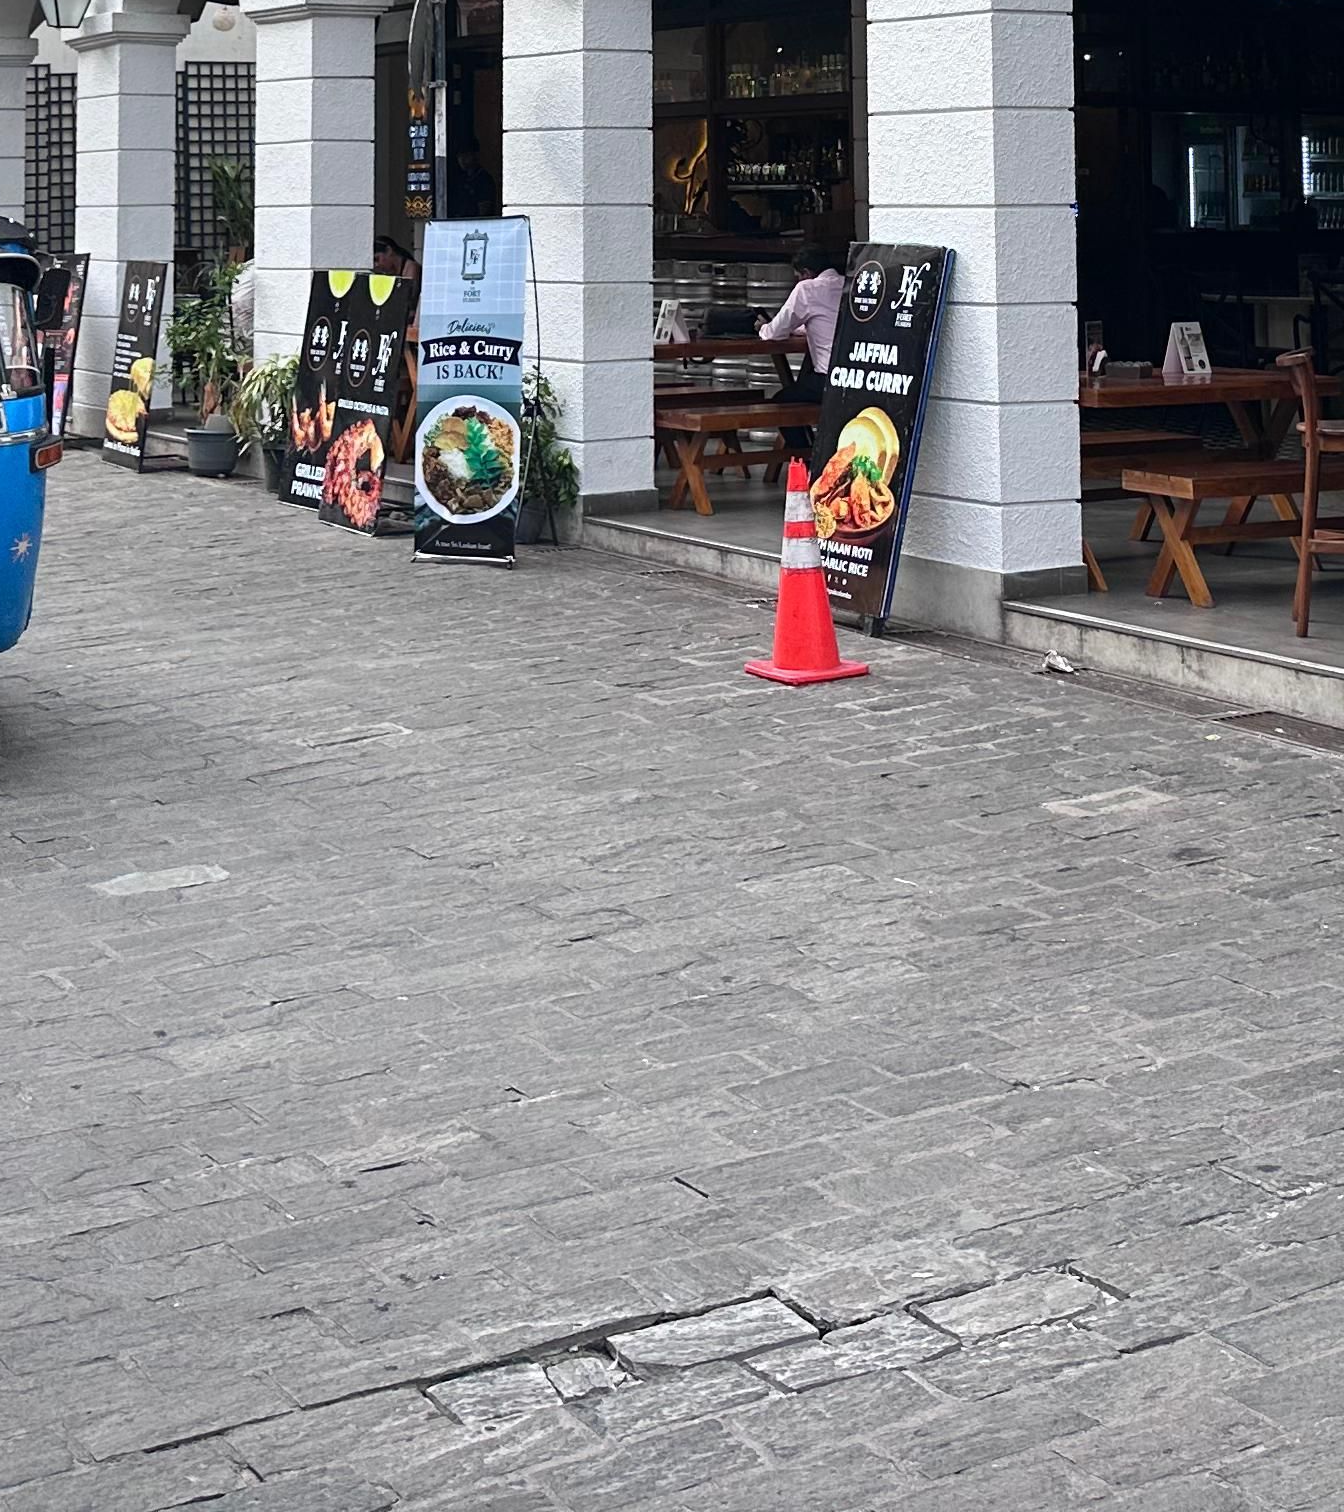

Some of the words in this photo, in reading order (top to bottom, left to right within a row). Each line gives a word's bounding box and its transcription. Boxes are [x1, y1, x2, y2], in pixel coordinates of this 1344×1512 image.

[429, 341, 456, 358] Rice
[459, 340, 471, 356] &
[473, 340, 515, 361] Curry
[848, 341, 899, 366] JAFFNA
[436, 364, 450, 380] IS
[453, 363, 505, 381] BACK!
[830, 366, 865, 389] CRAB
[865, 370, 914, 396] CURRY
[827, 540, 852, 556] NAAN
[851, 545, 873, 562] ROTI
[847, 562, 869, 577] RICE
